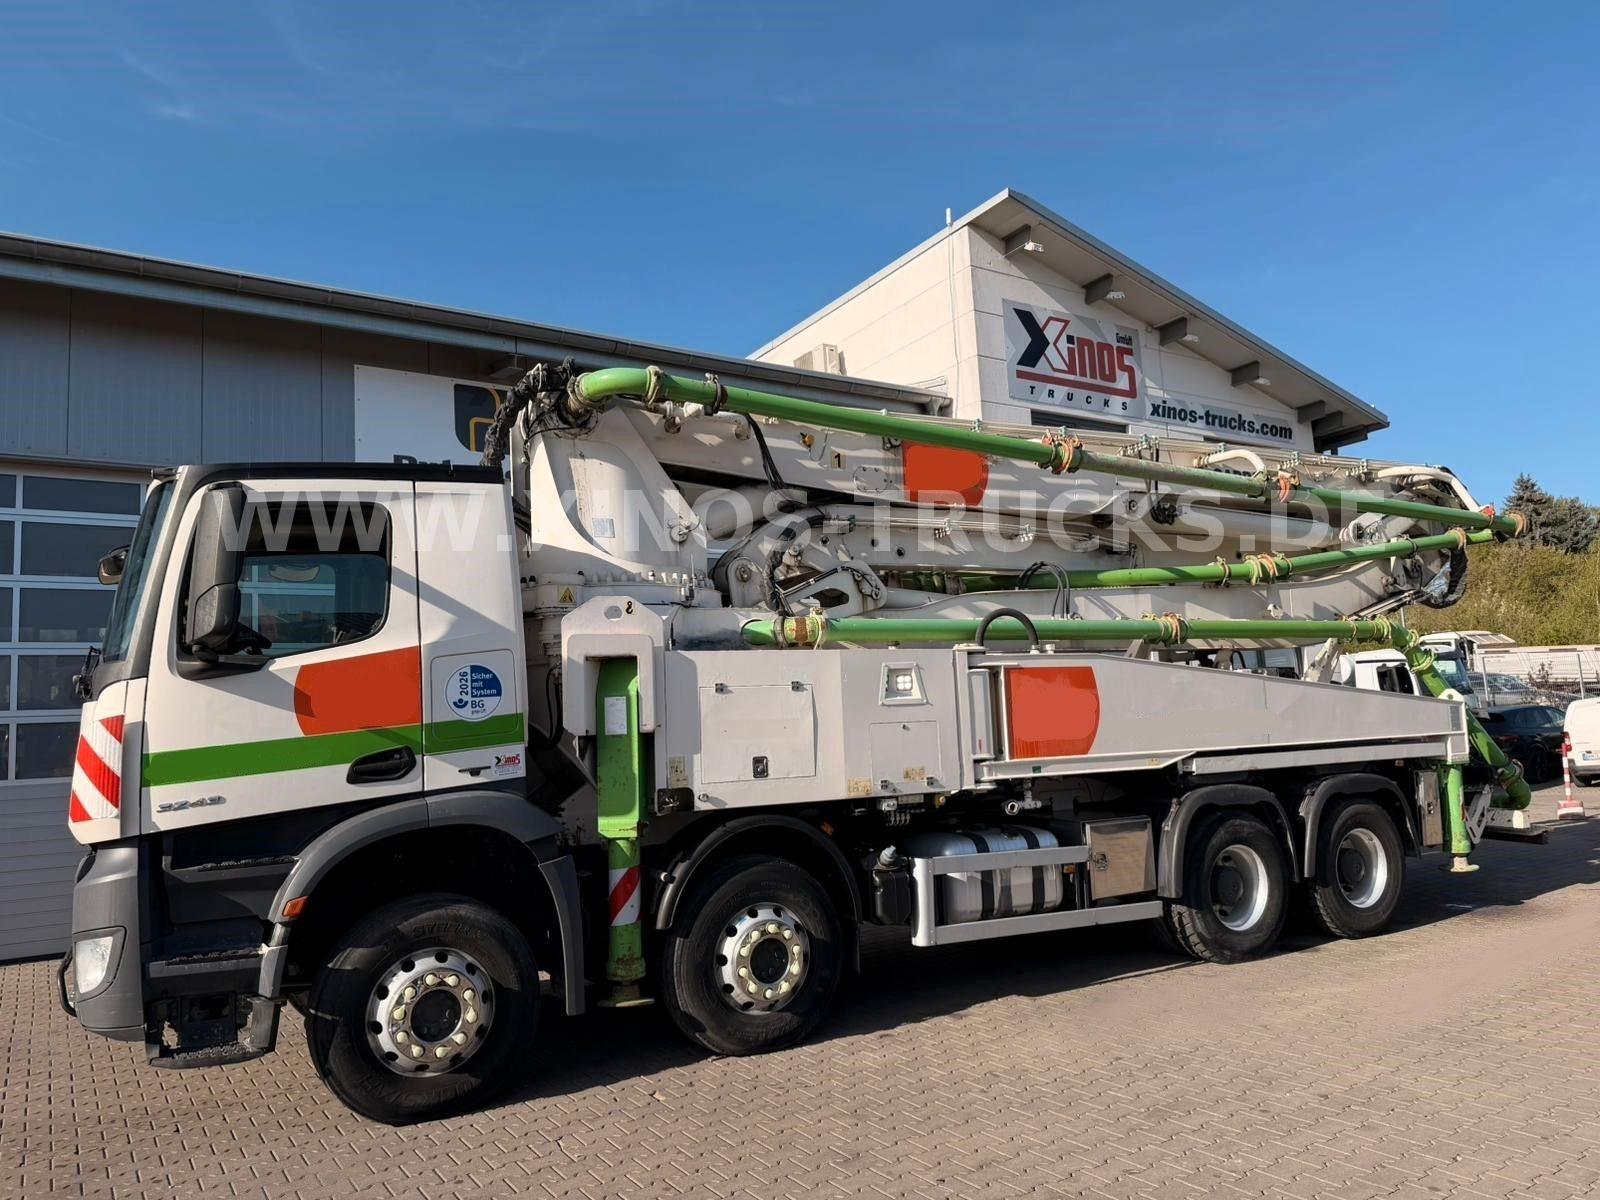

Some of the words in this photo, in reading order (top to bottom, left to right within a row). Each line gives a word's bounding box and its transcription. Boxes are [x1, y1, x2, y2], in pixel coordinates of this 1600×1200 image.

[1029, 385, 1128, 411] TRUCKS
[1150, 400, 1293, 440] xinos-trucks.com
[834, 452, 841, 468] 1
[459, 671, 469, 696] 2026
[471, 672, 493, 680] Sicher
[472, 689, 497, 697] System
[471, 700, 485, 709] BG
